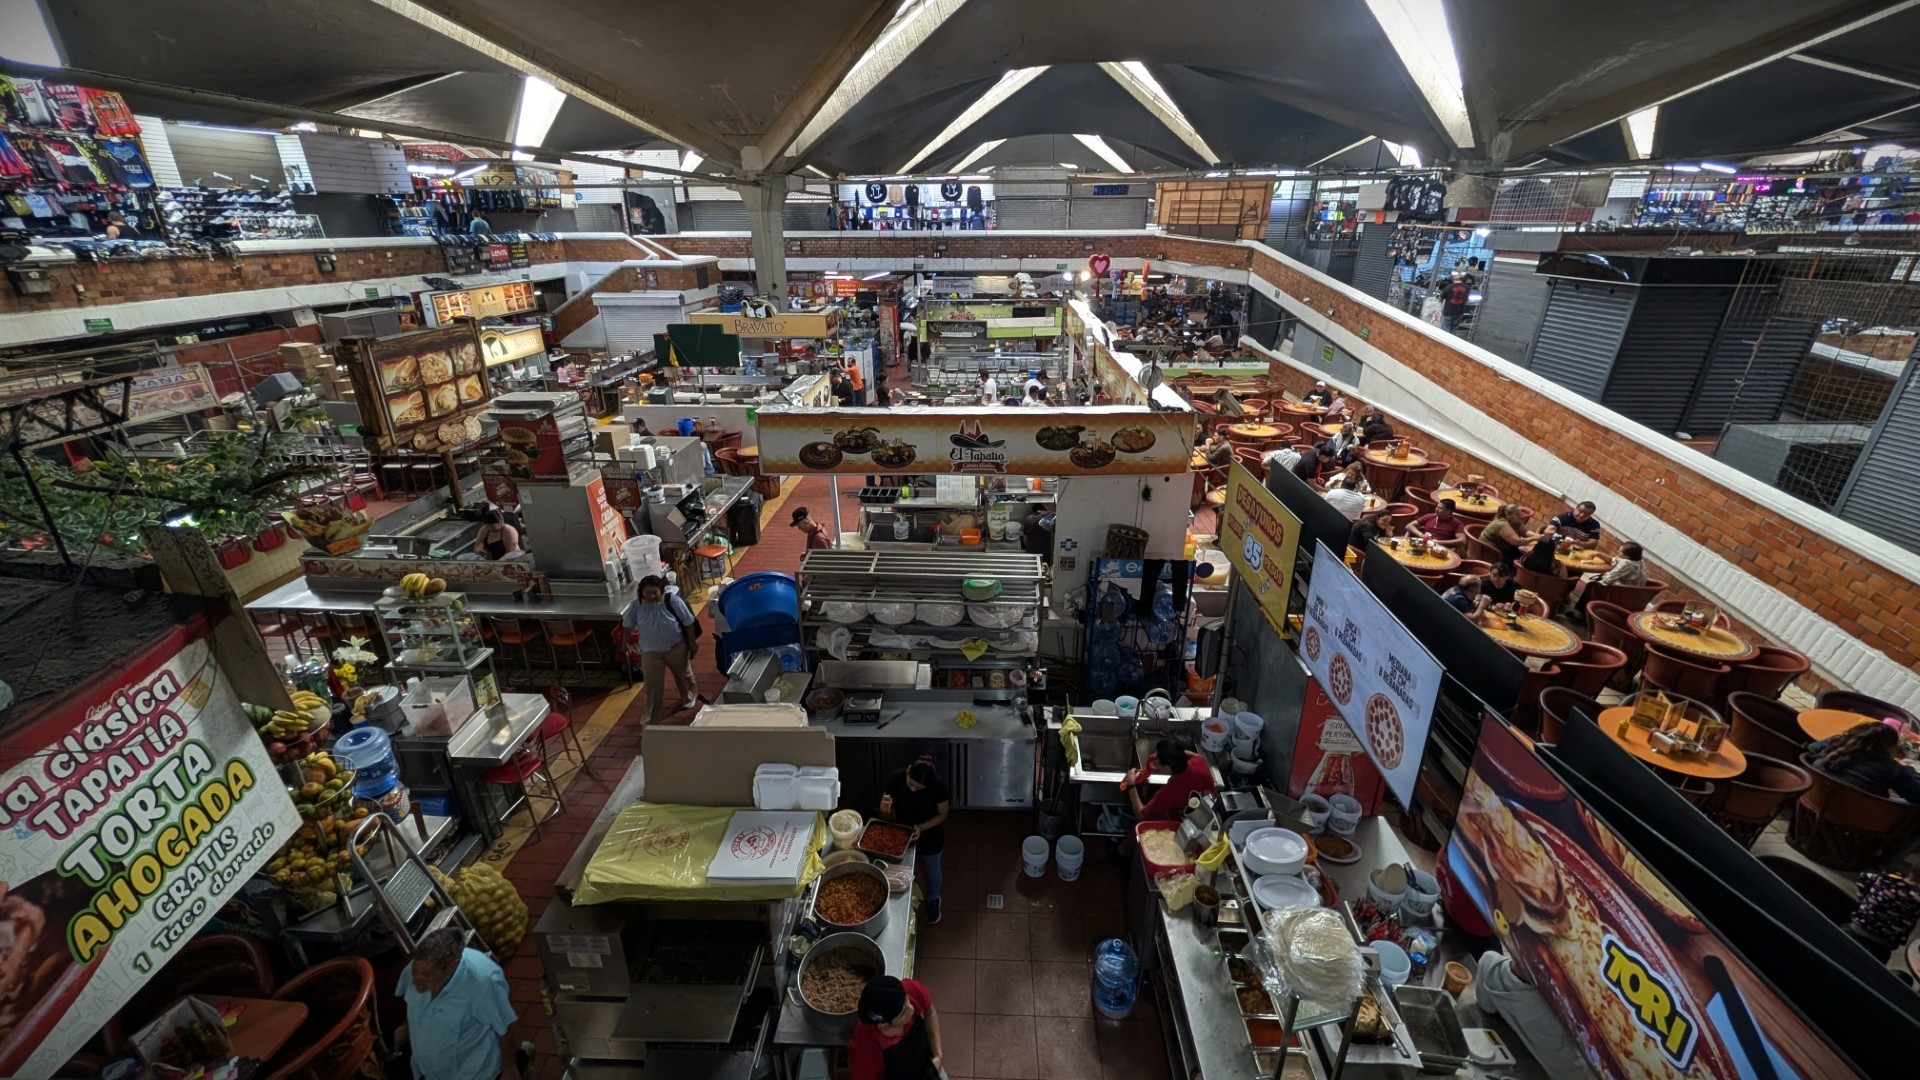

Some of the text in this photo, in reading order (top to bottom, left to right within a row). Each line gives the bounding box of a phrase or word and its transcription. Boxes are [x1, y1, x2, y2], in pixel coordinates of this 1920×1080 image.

[734, 319, 785, 333] BRAVATTO
[106, 375, 182, 393] SSANA
[949, 448, 963, 461] El
[1237, 485, 1283, 547] DESAYUNOS
[1244, 534, 1262, 571] 85
[1263, 555, 1284, 588] PESOS
[1338, 630, 1362, 663] REBANADAS
[1388, 652, 1411, 684] MEDIANA
[1397, 674, 1407, 690] CM
[1383, 670, 1413, 710] REBANADAS
[50, 673, 177, 780] clásica
[32, 715, 184, 836] TAPATÍA
[62, 743, 213, 882] TORTA
[72, 762, 253, 960] AHOGADA
[154, 827, 237, 920] GRATIS
[134, 825, 275, 973] 1 Taco dorado
[1605, 942, 1691, 1058] TORI
